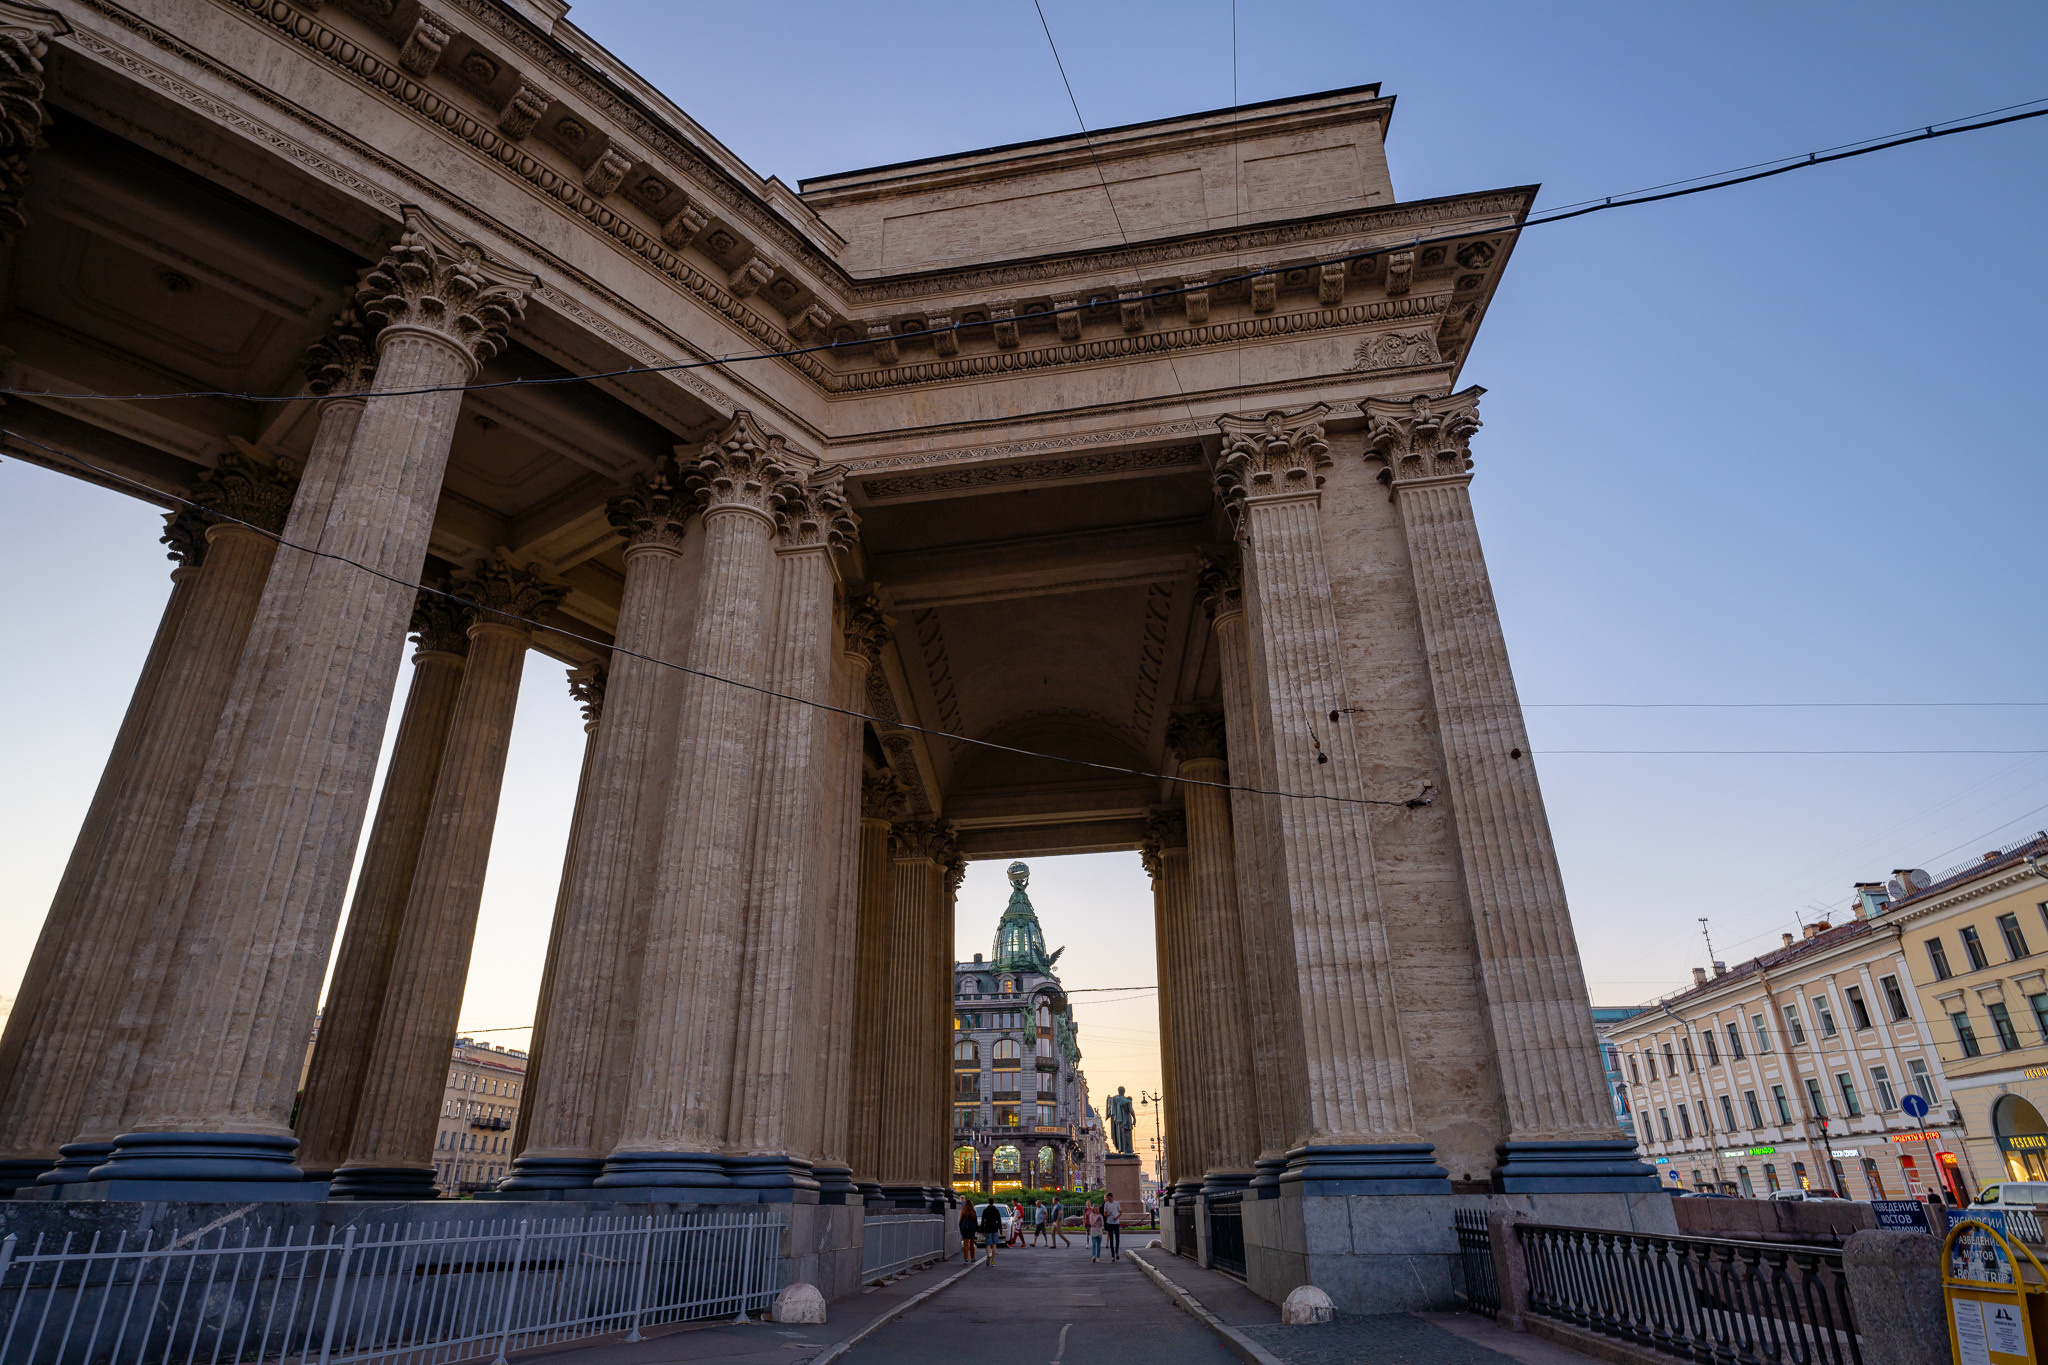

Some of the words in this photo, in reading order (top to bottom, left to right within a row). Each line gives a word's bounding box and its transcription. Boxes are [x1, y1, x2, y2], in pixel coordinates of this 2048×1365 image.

[1891, 1133, 1919, 1143] ПРОДУКТЫ
[2009, 1136, 2047, 1148] PESERICO
[1881, 1214, 1913, 1224] МОСТОВ
[1957, 1235, 2001, 1247] АЗВЕДЕНИ
[1963, 1249, 1994, 1261] МОСТОВ
